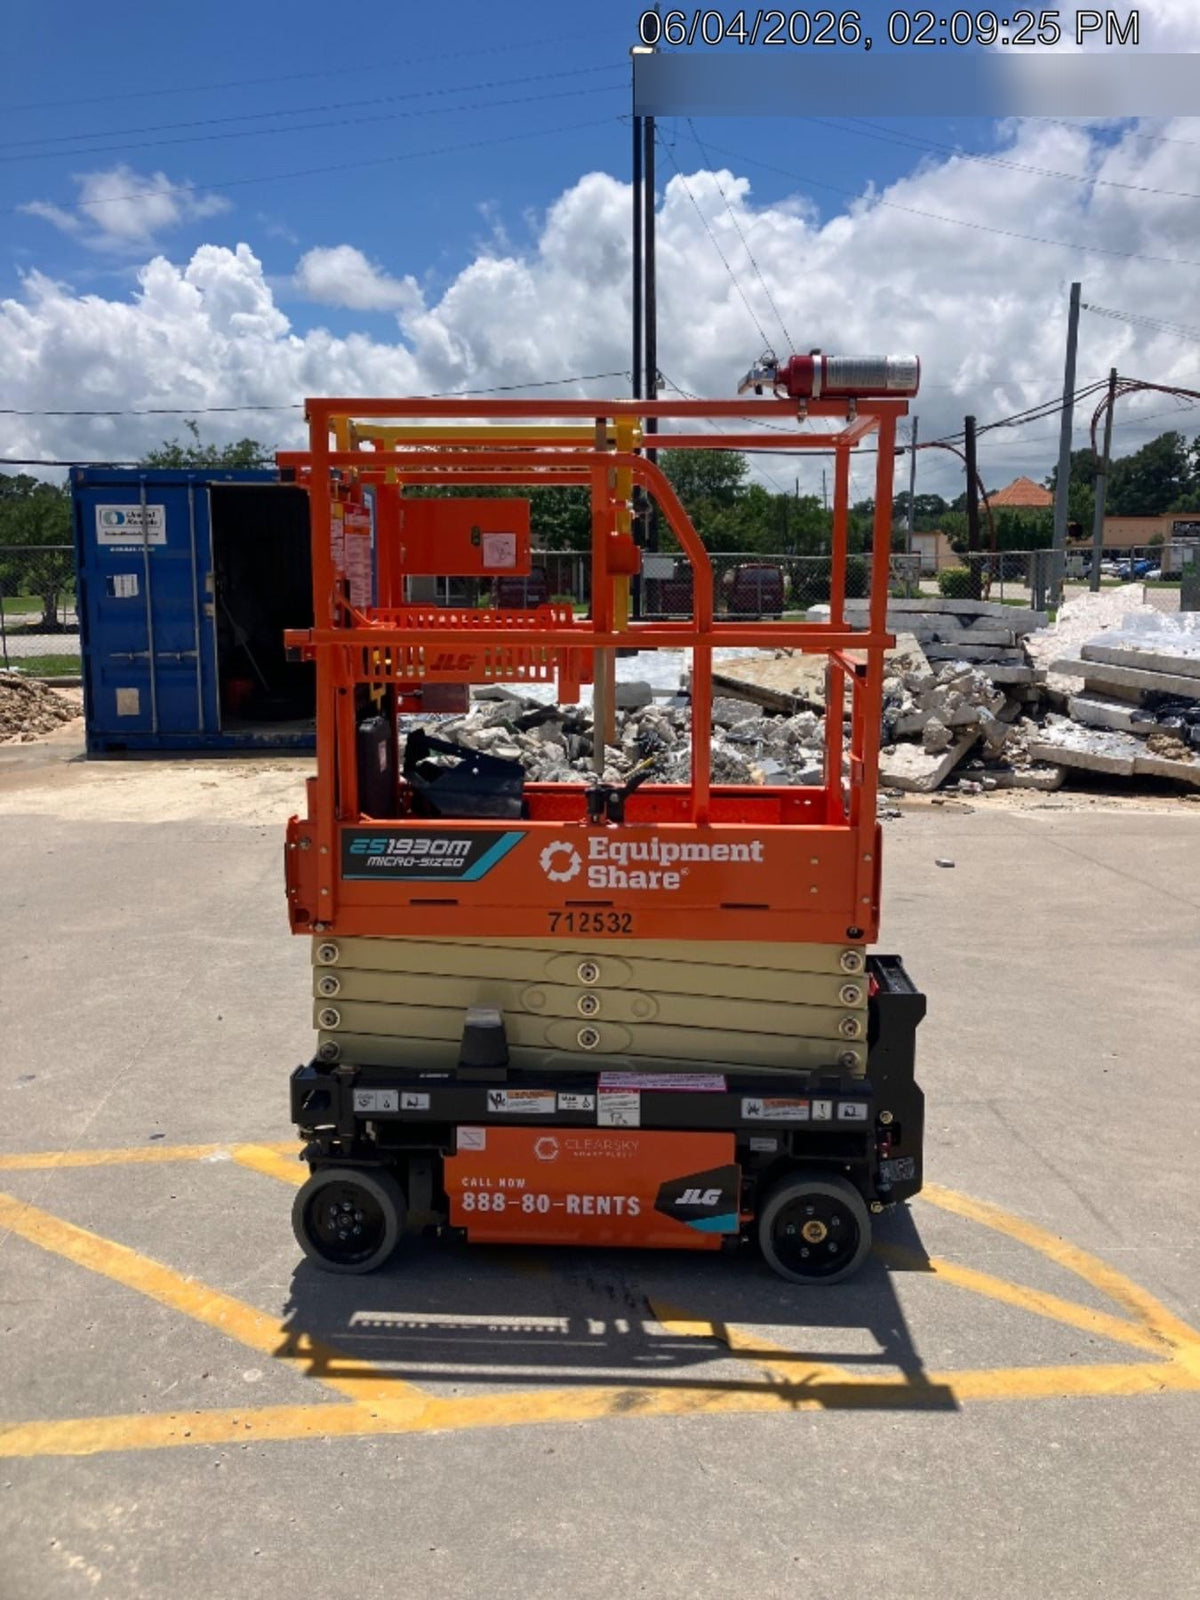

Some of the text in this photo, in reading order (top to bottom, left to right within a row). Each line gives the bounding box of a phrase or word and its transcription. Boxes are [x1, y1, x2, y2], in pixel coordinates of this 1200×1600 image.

[350, 838, 472, 856] ES1930M
[588, 836, 764, 866] Equipment
[366, 856, 465, 867] MICRO-SIZED
[588, 865, 681, 889] Share
[548, 911, 633, 933] 712532
[564, 1139, 640, 1152] CLEARSKY
[461, 1177, 526, 1188] CALL NOW
[461, 1192, 641, 1216] 888-80-RENTS
[674, 1188, 722, 1206] JLG
